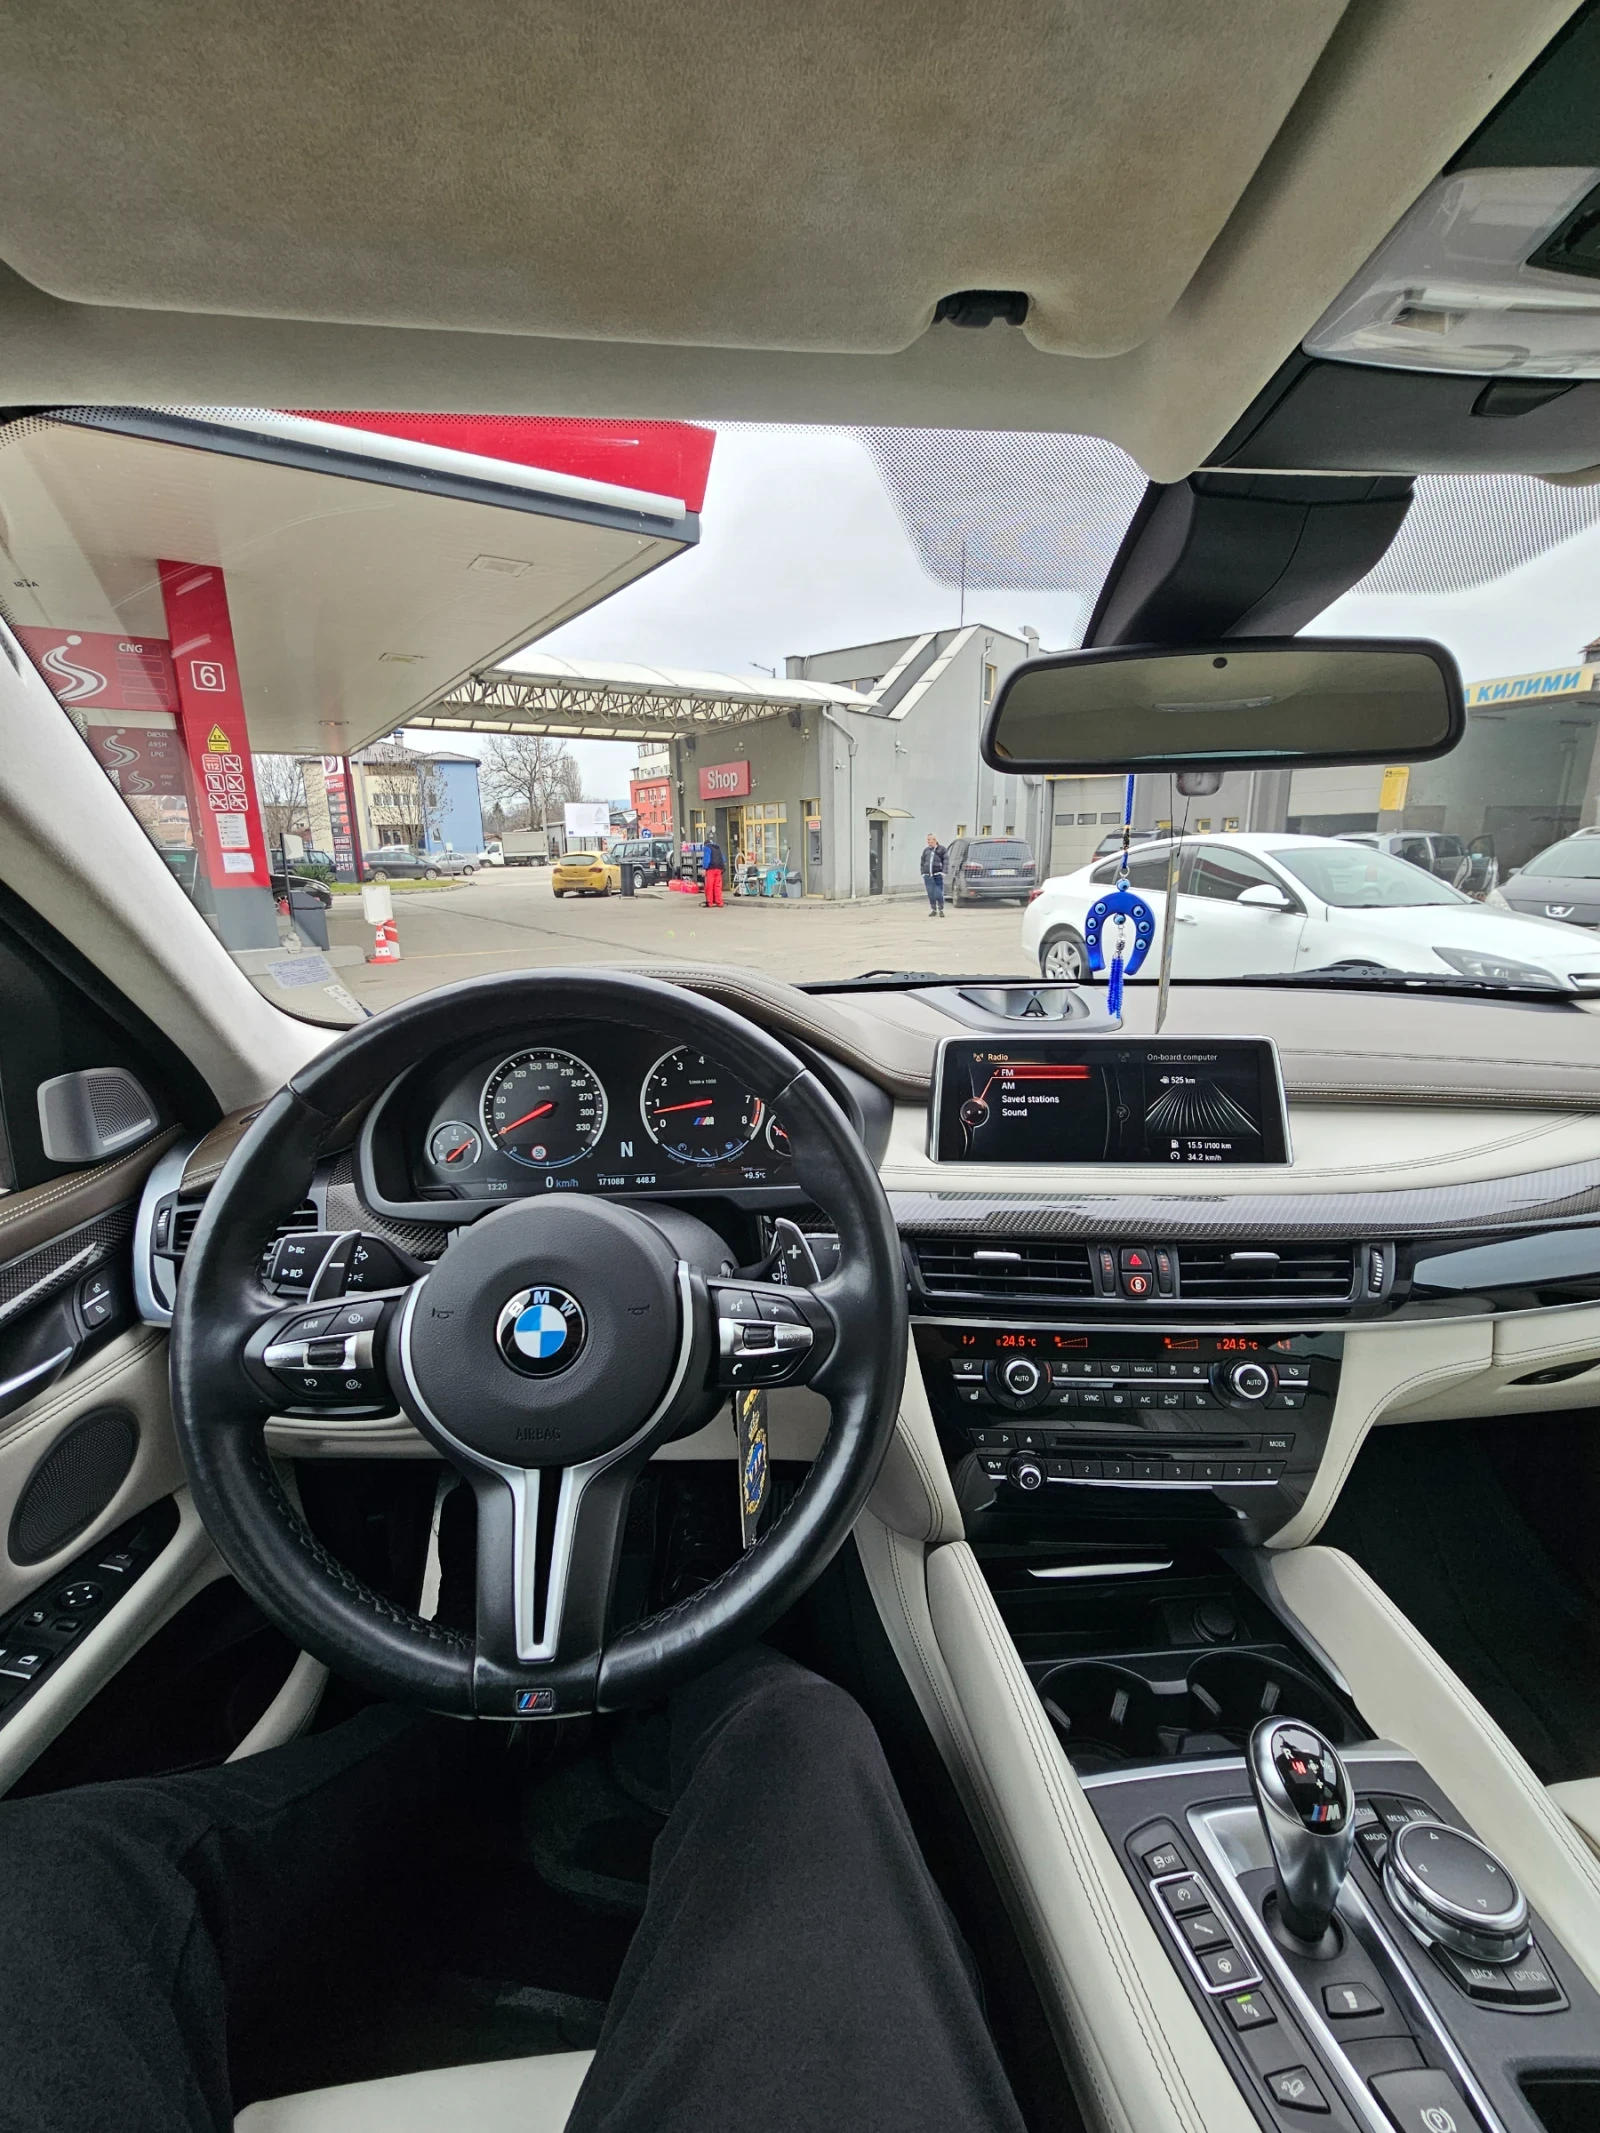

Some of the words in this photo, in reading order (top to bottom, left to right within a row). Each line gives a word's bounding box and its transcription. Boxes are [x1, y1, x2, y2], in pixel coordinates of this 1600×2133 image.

[118, 643, 142, 654] CNG
[200, 666, 216, 687] 6
[1477, 671, 1582, 702] КИЛИМИ
[206, 762, 220, 770] 112
[708, 770, 738, 792] Shop
[698, 1056, 704, 1064] 4
[677, 1062, 684, 1070] 3
[660, 1078, 668, 1086] 2
[655, 1098, 660, 1106] 1
[745, 1095, 750, 1104] 7
[660, 1120, 666, 1128] 0
[742, 1116, 748, 1124] 8
[620, 1141, 634, 1157] N
[546, 1176, 554, 1188] 0
[556, 1178, 578, 1188] km/h
[508, 1290, 576, 1318] BMW
[303, 1320, 318, 1329] LIM
[1002, 1336, 1025, 1347] 24.5
[1223, 1338, 1246, 1350] 24.5
[516, 1427, 560, 1440] AIRBAG
[1283, 1748, 1294, 1760] R
[1354, 1808, 1375, 1816] EDIA
[1413, 1809, 1428, 1818] TEL
[1364, 1833, 1387, 1841] RADIO
[1165, 1856, 1176, 1864] OFF
[1470, 1968, 1498, 1980] BACK
[1514, 1970, 1547, 1981] OPTION
